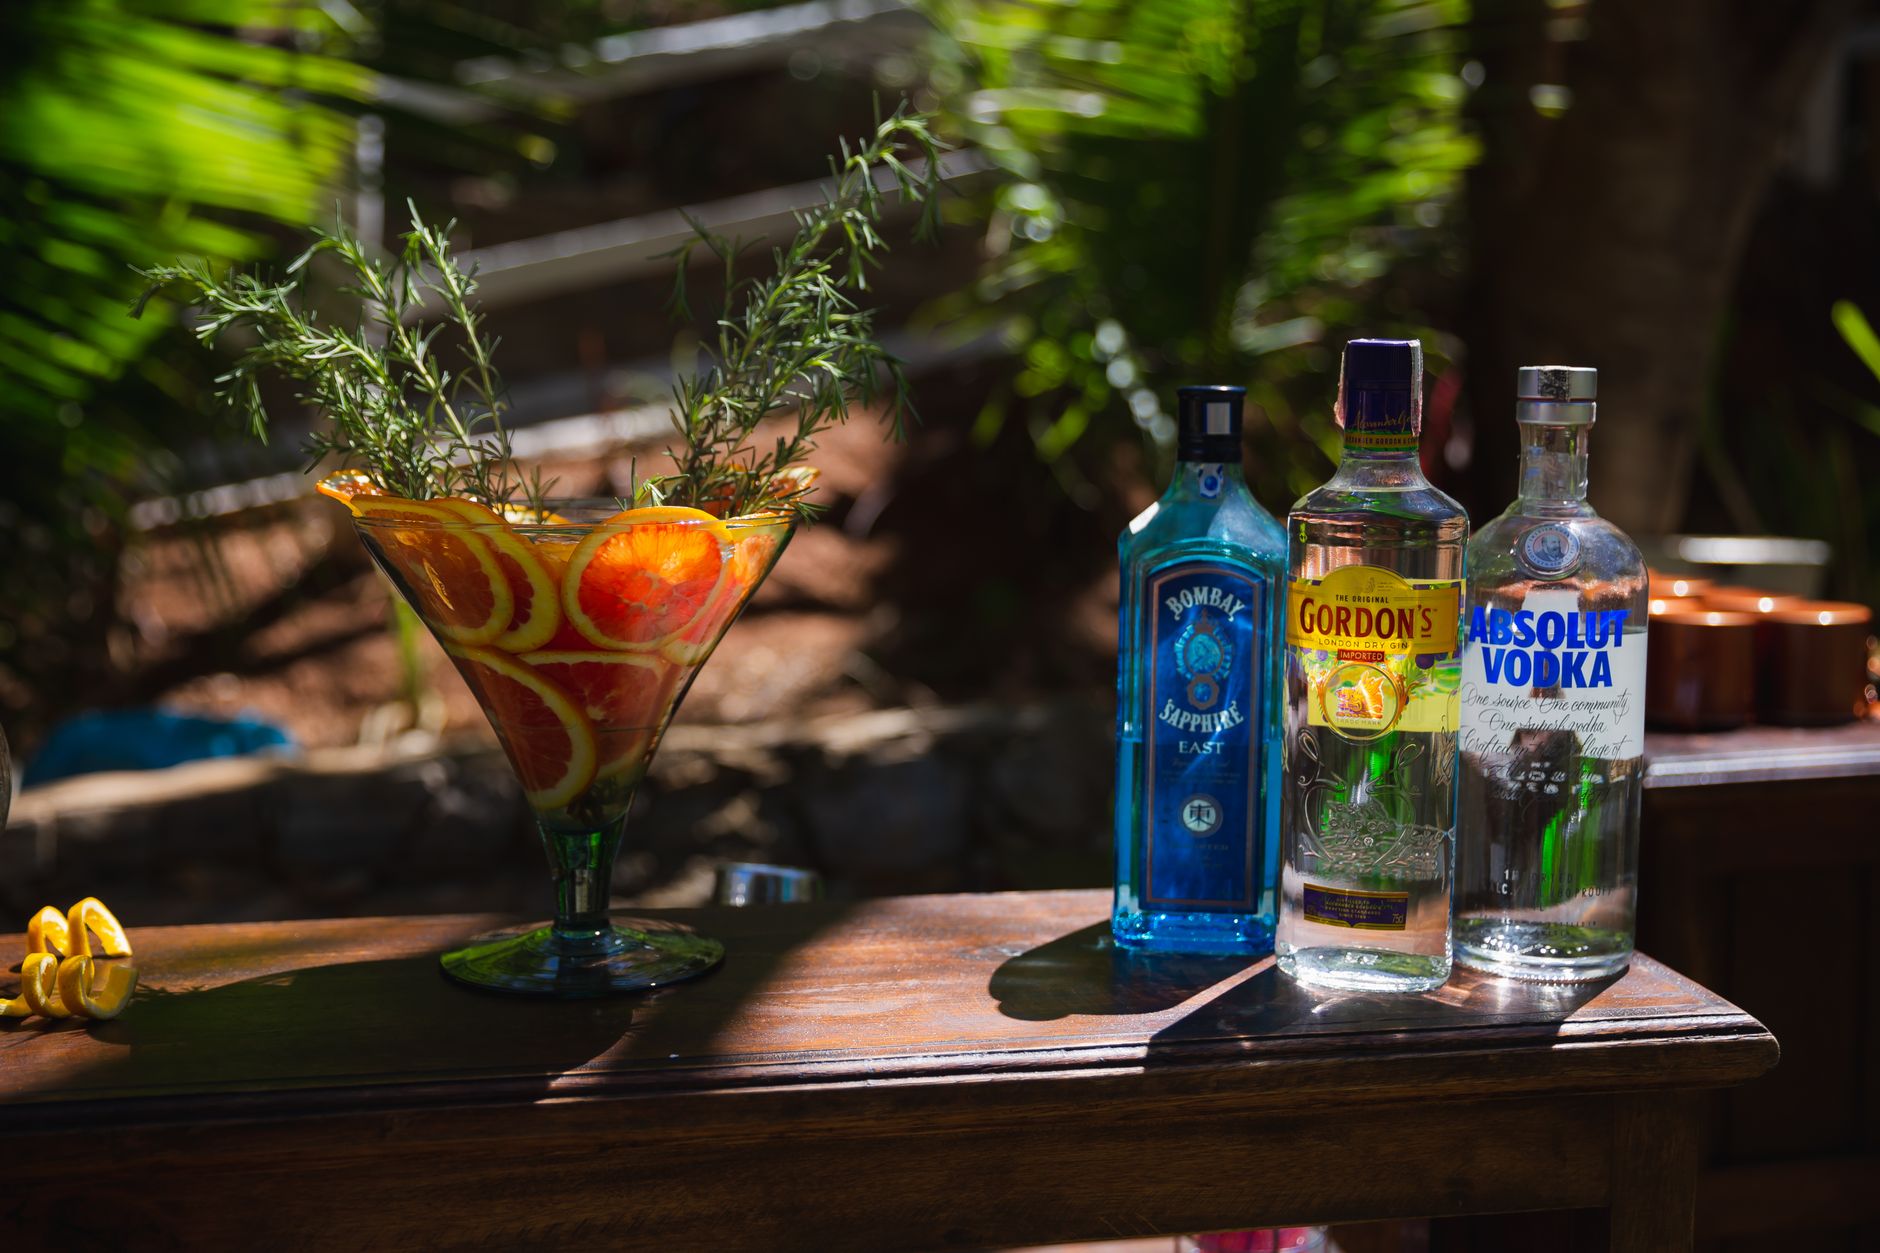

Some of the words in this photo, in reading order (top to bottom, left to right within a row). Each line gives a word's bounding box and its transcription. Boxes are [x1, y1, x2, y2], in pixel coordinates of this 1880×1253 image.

[1165, 586, 1245, 622] BOMBAY
[1336, 594, 1349, 602] THE
[1352, 595, 1389, 604] ORIGINAL
[1469, 605, 1631, 650] ABSOLUT
[1318, 638, 1360, 648] LONDON
[1364, 641, 1384, 649] DRY
[1340, 651, 1383, 661] IMPORTED
[1481, 646, 1612, 689] VODKA
[1461, 682, 1489, 705] One
[1534, 692, 1569, 714] One
[1159, 699, 1244, 733] SAPPHIRE
[1478, 708, 1515, 732] One
[1179, 741, 1224, 754] EAST
